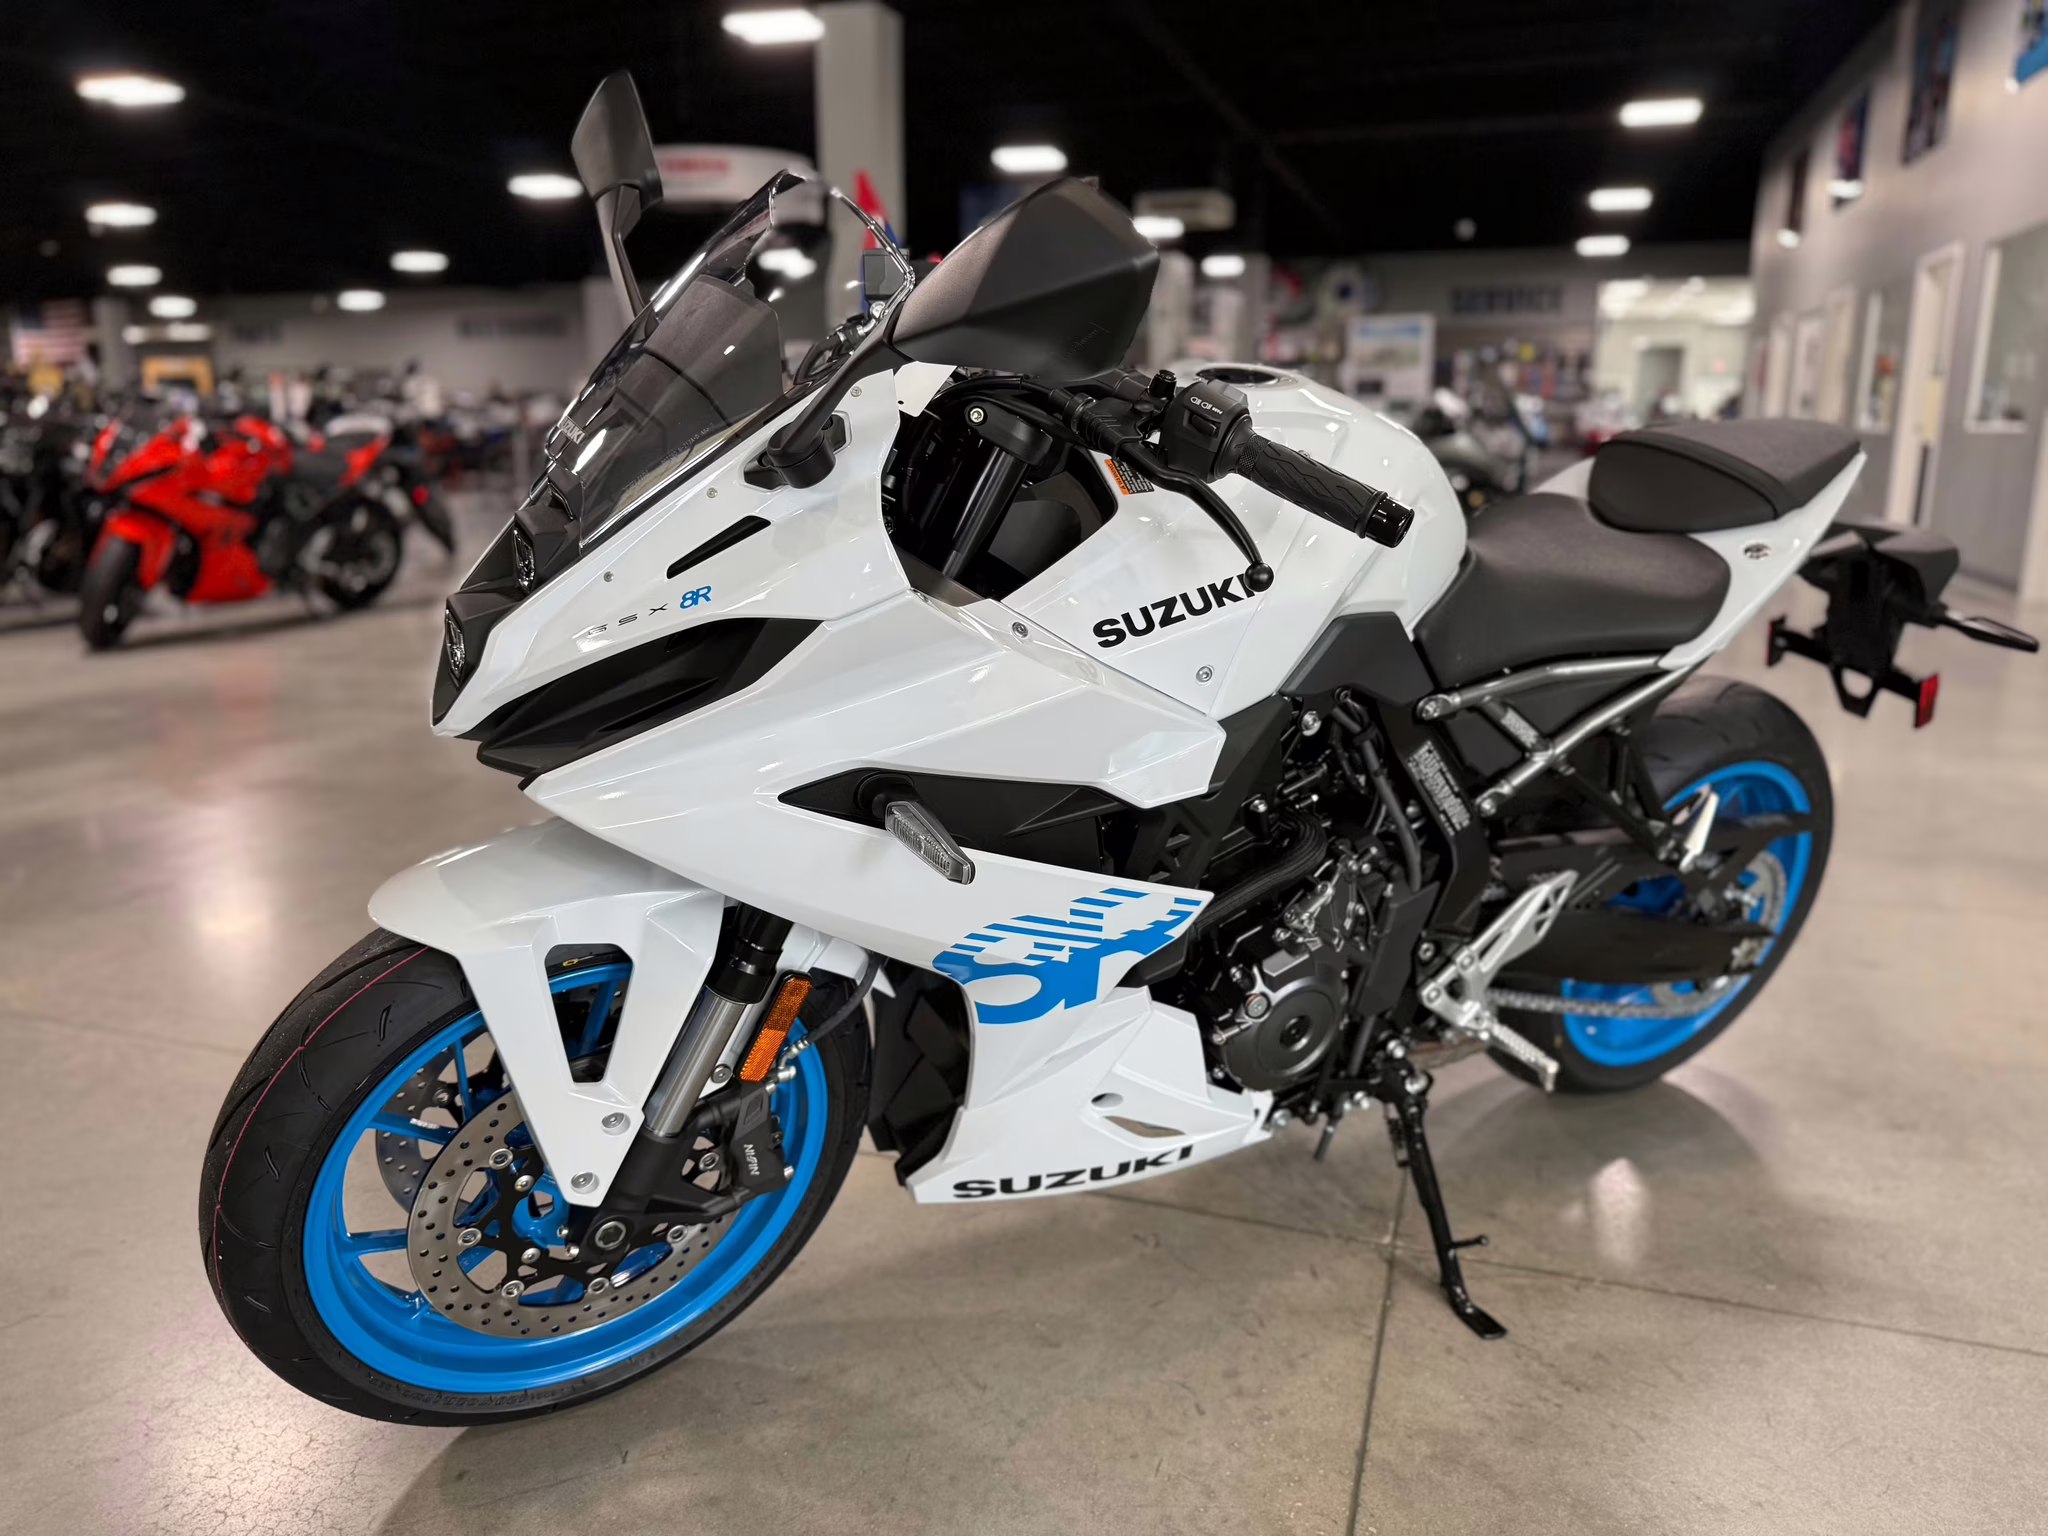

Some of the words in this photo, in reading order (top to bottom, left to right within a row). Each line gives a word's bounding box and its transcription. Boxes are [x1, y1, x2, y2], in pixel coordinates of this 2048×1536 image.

[679, 585, 712, 609] 8R
[1092, 573, 1256, 648] SUZUKI
[952, 1144, 1193, 1198] SUZUKI
